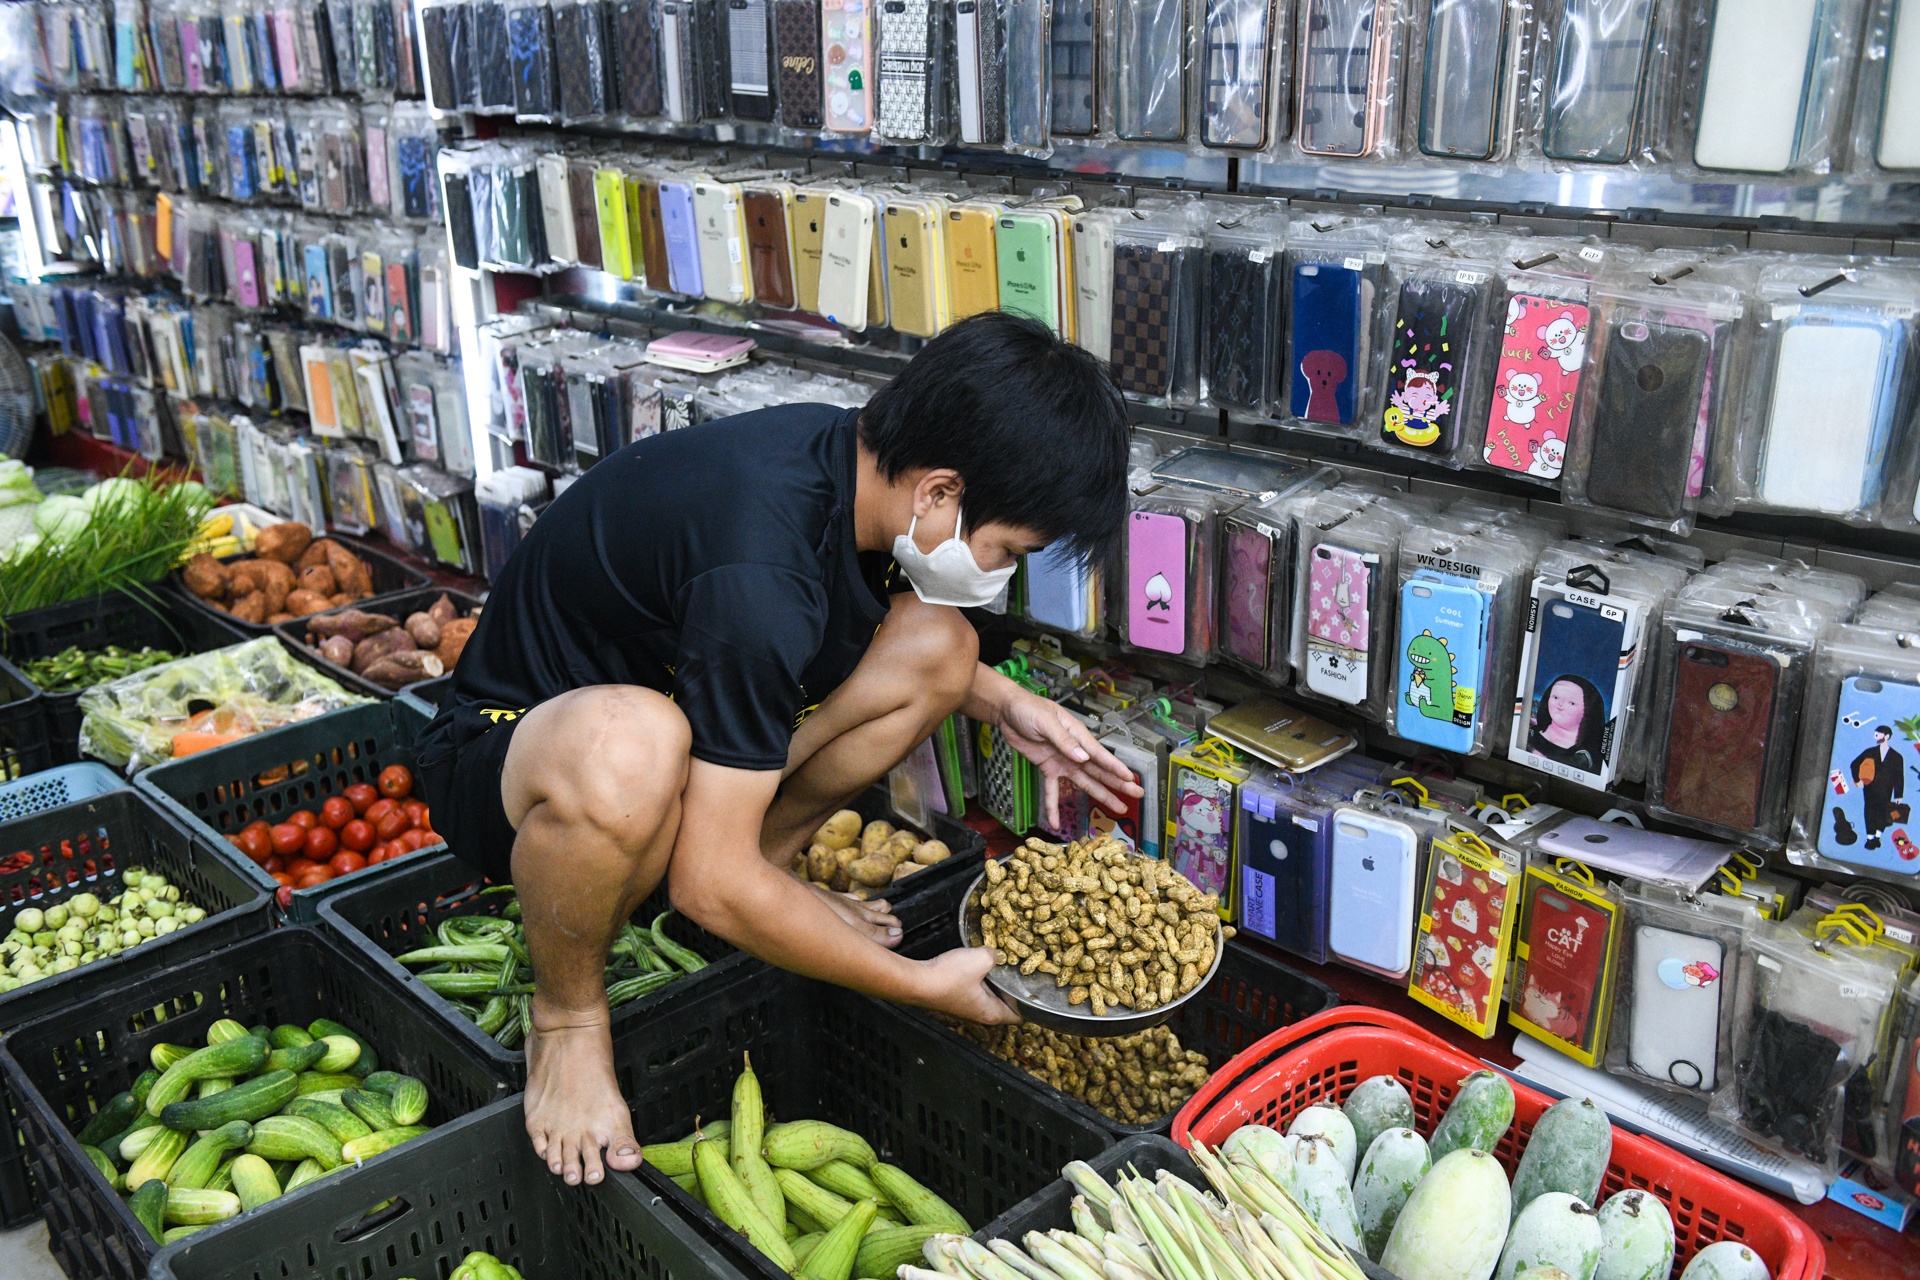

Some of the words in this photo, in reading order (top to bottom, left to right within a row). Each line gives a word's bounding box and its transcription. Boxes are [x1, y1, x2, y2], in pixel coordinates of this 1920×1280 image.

[783, 55, 815, 74] Celine
[881, 60, 909, 72] CHRISTIAN
[910, 62, 925, 73] DIOR
[1501, 343, 1532, 363] luck
[1545, 391, 1575, 420] rich
[1417, 553, 1435, 567] WK
[1438, 558, 1480, 576] DESIGN
[1569, 593, 1596, 606] CASE
[1434, 615, 1464, 629] Summer
[1527, 600, 1538, 631] FASHION
[1605, 608, 1618, 618] 6P
[1320, 667, 1347, 682] FASHION
[1459, 692, 1473, 700] New
[1453, 717, 1471, 726] DESIGN
[1600, 726, 1610, 755] CREATIVE
[1194, 765, 1216, 777] FASHION
[1458, 853, 1483, 869] FASHION
[1255, 872, 1263, 898] CASE
[1555, 881, 1583, 899] FASHION
[1247, 895, 1256, 928] SMART
[1255, 898, 1264, 932] PHONE
[1547, 927, 1582, 953] CAT
[1544, 940, 1562, 953] Happy
[1562, 949, 1574, 959] Eye
[1551, 952, 1566, 963] LOVE
[1546, 955, 1567, 970] SLOWLY
[1411, 987, 1442, 1009] CREATIVE
[1446, 1003, 1475, 1027] CASE
